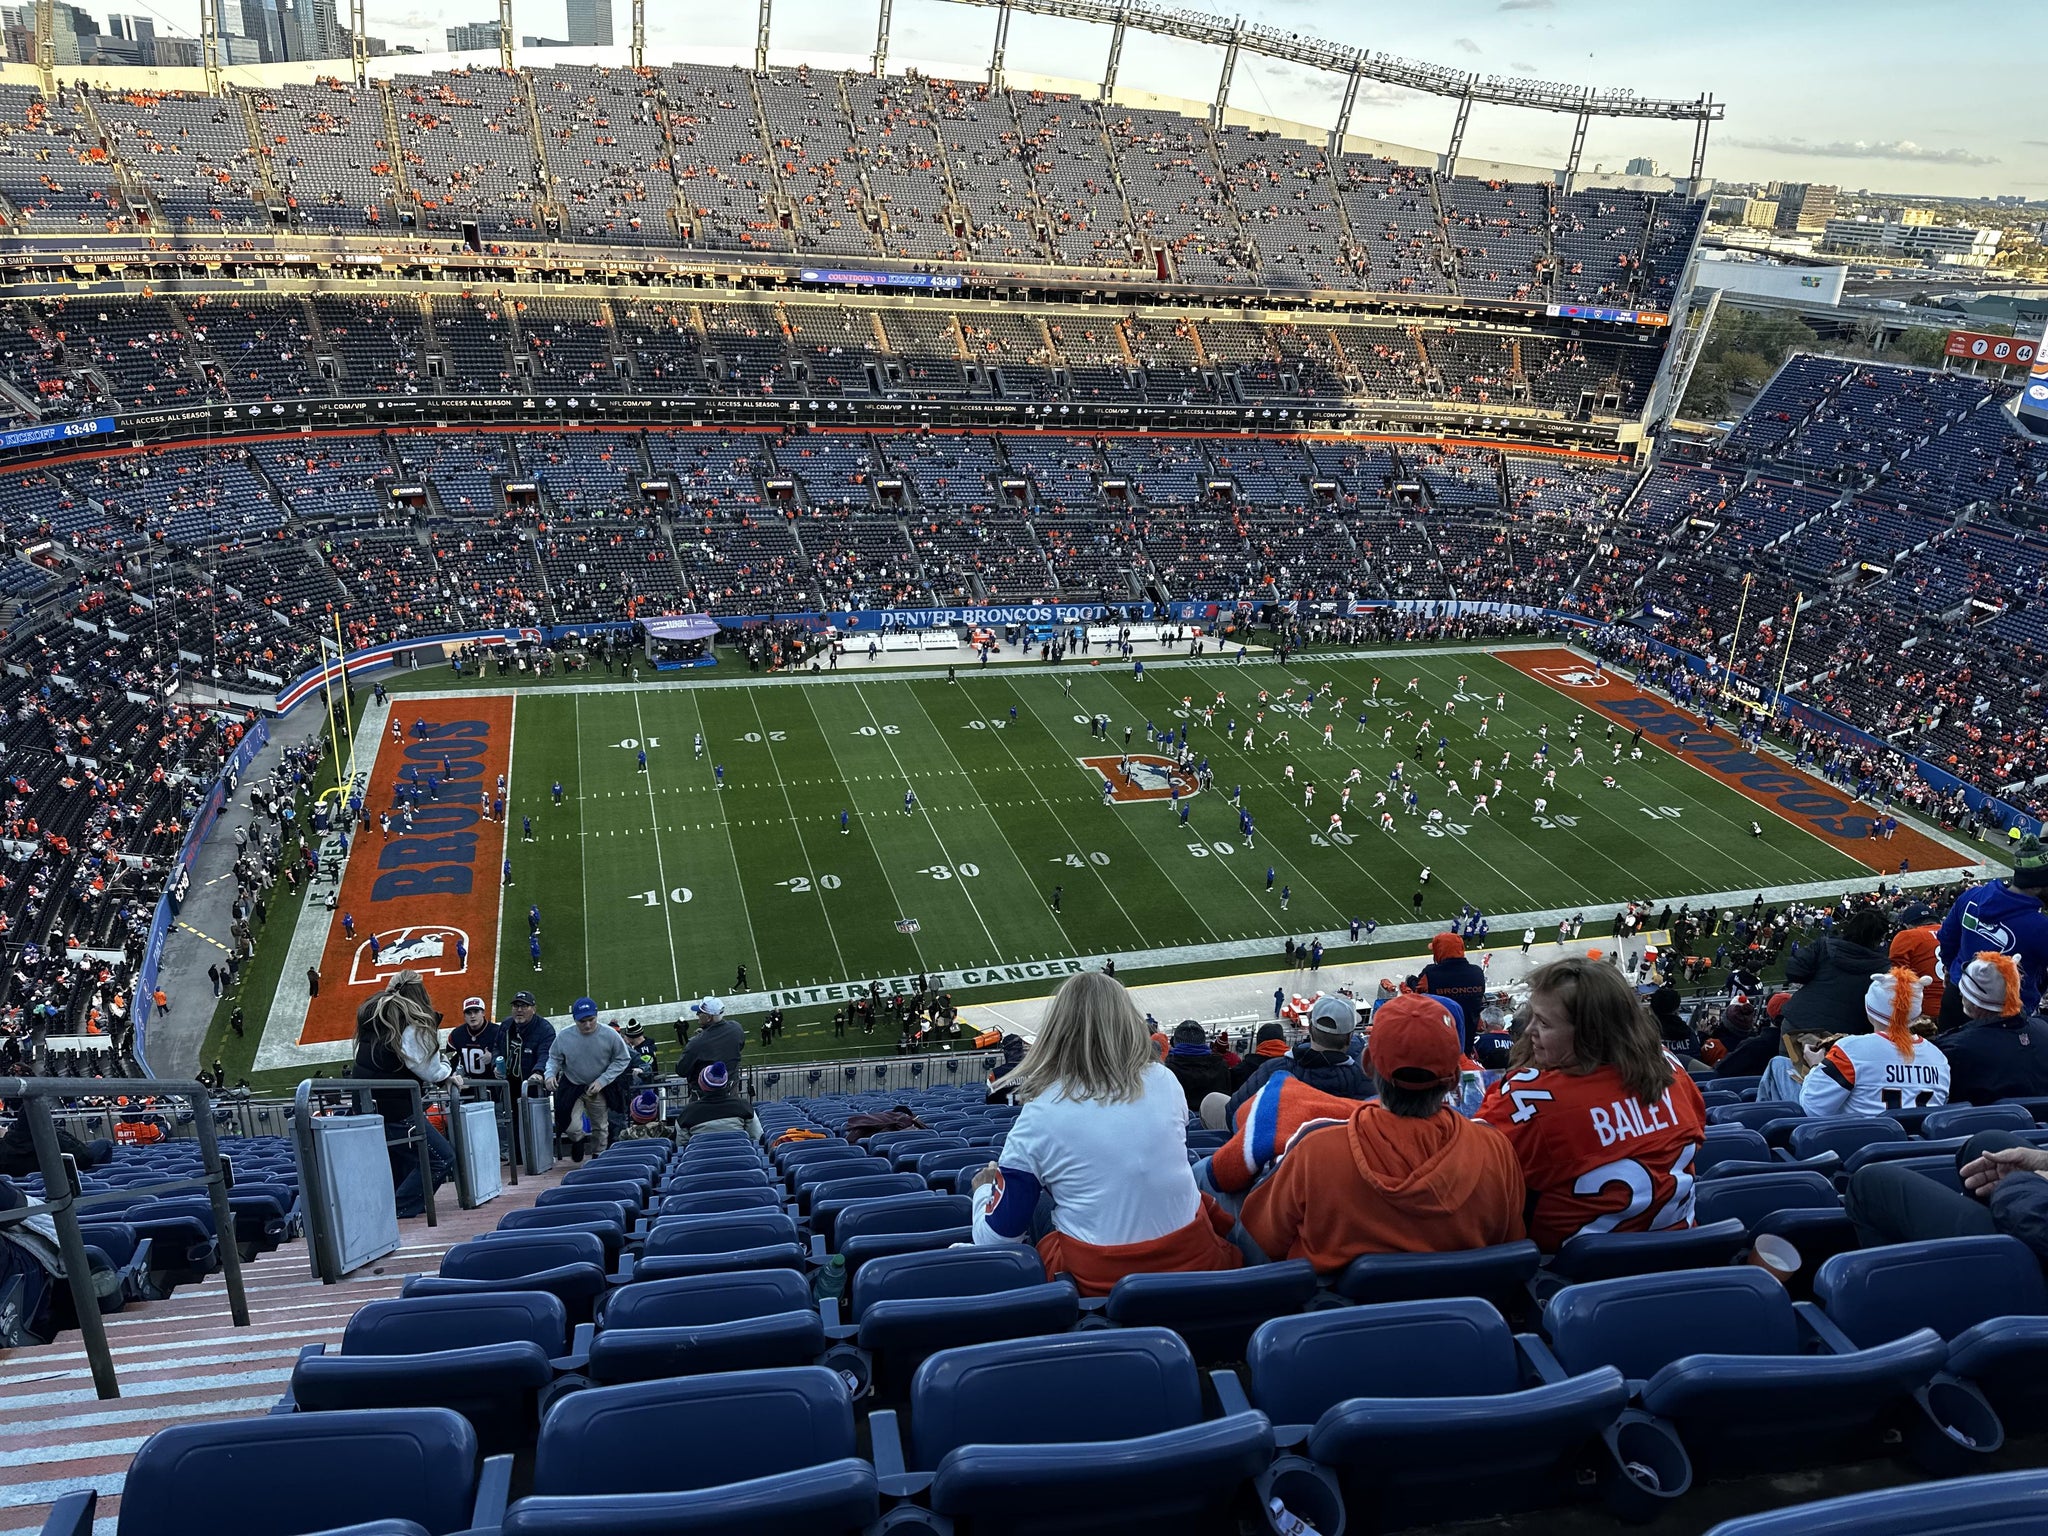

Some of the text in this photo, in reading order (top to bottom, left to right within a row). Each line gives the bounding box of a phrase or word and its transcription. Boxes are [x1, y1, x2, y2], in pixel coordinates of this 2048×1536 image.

[7, 256, 33, 264] SMITH
[75, 254, 140, 263] 65 ZIMMERMAN
[187, 254, 197, 262] 30
[284, 254, 310, 262] SMITH
[420, 257, 449, 265] REEVES
[618, 263, 645, 271] BAILEY
[678, 265, 716, 273] SHANAHAN
[827, 273, 876, 282] COUNTDOWN
[930, 276, 957, 286] 43:49
[1977, 343, 1984, 351] 7
[1996, 345, 2008, 355] 18
[2018, 348, 2030, 358] 44
[318, 402, 367, 410] NFL.COM/VIP
[120, 411, 213, 426] ALL ACCESS. ALL SEASON.
[5, 421, 98, 445] KICKOFF 43:49
[1535, 424, 1574, 432] NFL.COM/VIP
[30, 541, 52, 553] CAMPOS
[880, 611, 957, 628] DENVER
[962, 607, 1051, 623] BRONCOS
[859, 724, 901, 736] 30
[969, 719, 1007, 730] 40
[619, 736, 661, 749] 10
[744, 730, 787, 743] 20
[1595, 698, 1888, 839] BRONCOS
[370, 720, 491, 903] BRONCOS
[1639, 805, 1682, 820] 10
[1530, 814, 1578, 830] 20
[1420, 822, 1469, 838] 30
[1310, 832, 1354, 847] 40
[1186, 840, 1235, 858] 50
[1064, 851, 1111, 869] 40
[930, 862, 981, 881] 30
[788, 873, 842, 893] 20
[643, 886, 693, 908] 10
[961, 961, 1084, 985] CANCER
[1436, 985, 1483, 995] BRONCOS
[461, 1047, 486, 1075] 10
[1886, 1064, 1939, 1085] SUTTON
[1501, 1067, 1553, 1124] 24
[1590, 1086, 1679, 1148] BAILEY
[1562, 1143, 1697, 1250] 24
